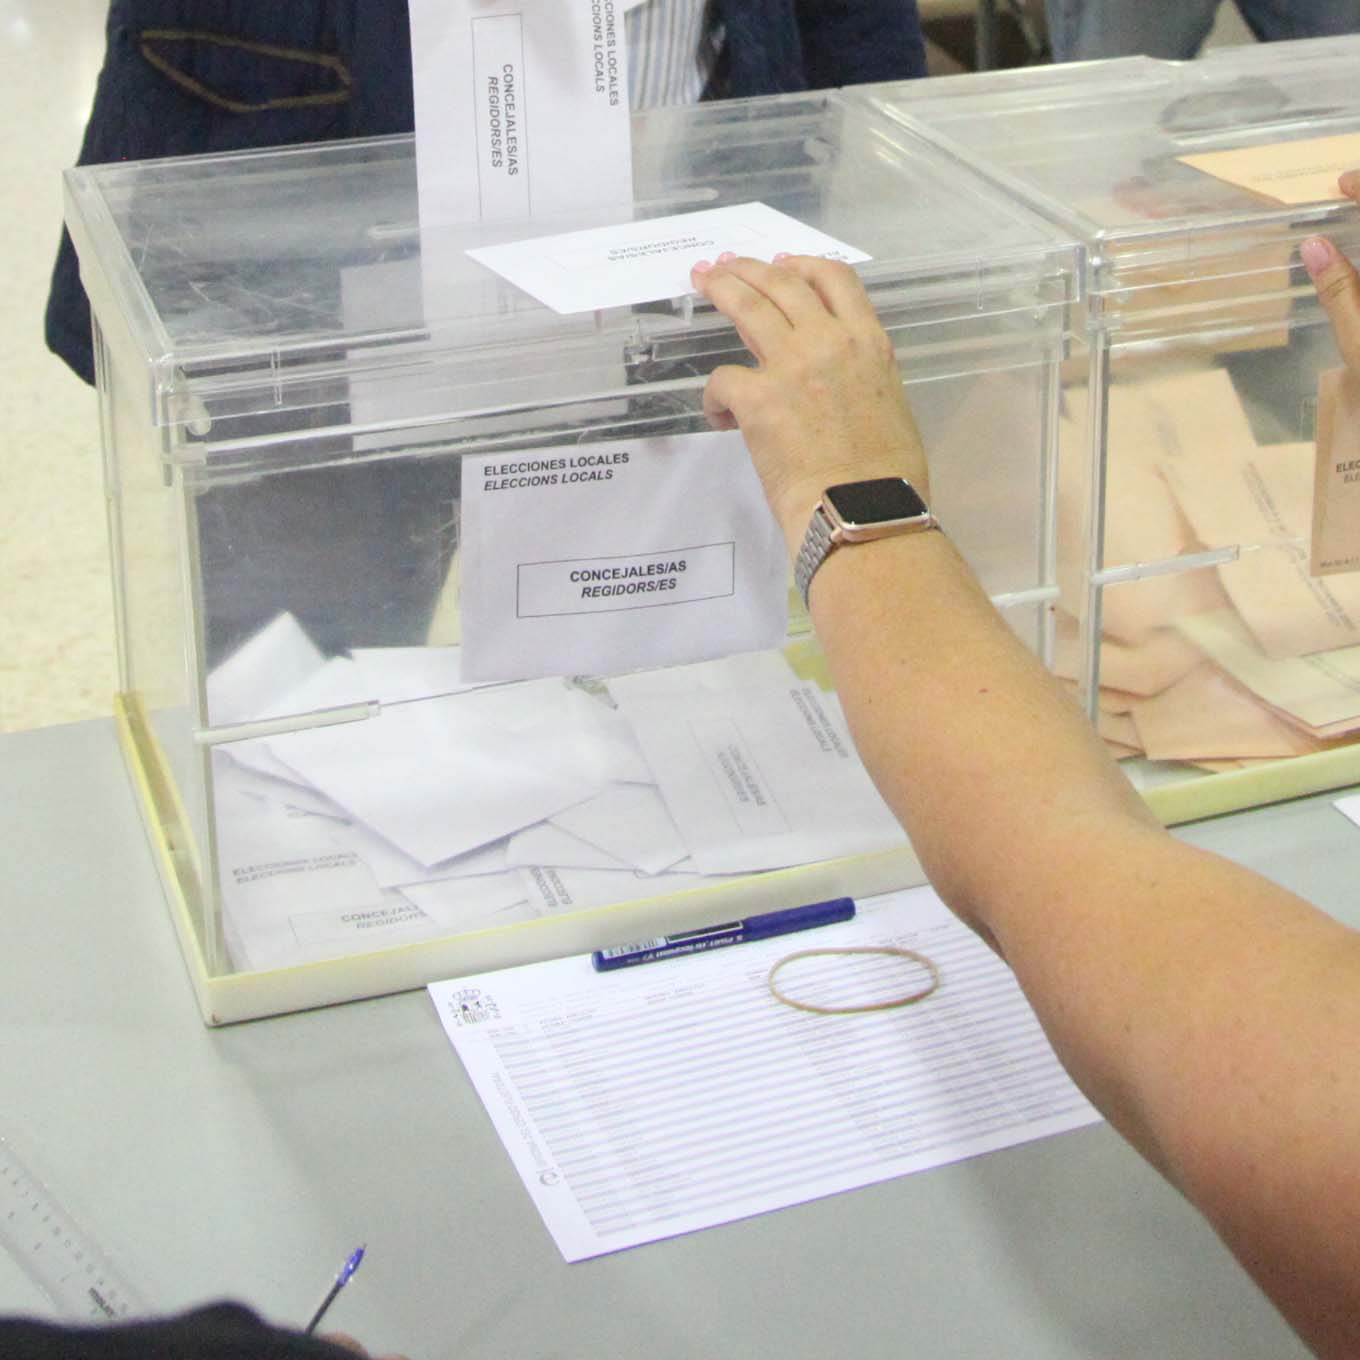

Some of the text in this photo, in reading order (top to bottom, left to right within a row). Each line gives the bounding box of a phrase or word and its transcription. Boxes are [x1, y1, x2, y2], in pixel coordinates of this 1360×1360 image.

[594, 44, 605, 94] LOCALS
[606, 49, 619, 107] LOCALES
[487, 75, 503, 169] REGIDORS/ES
[502, 63, 519, 177] CONCEJALES/AS
[483, 452, 630, 477] ELECCIONES LOCALES
[483, 468, 614, 492] ELECCIONS LOCALS
[569, 559, 688, 583] CONCEJALES/AS
[580, 577, 678, 600] REGIDORS/ES
